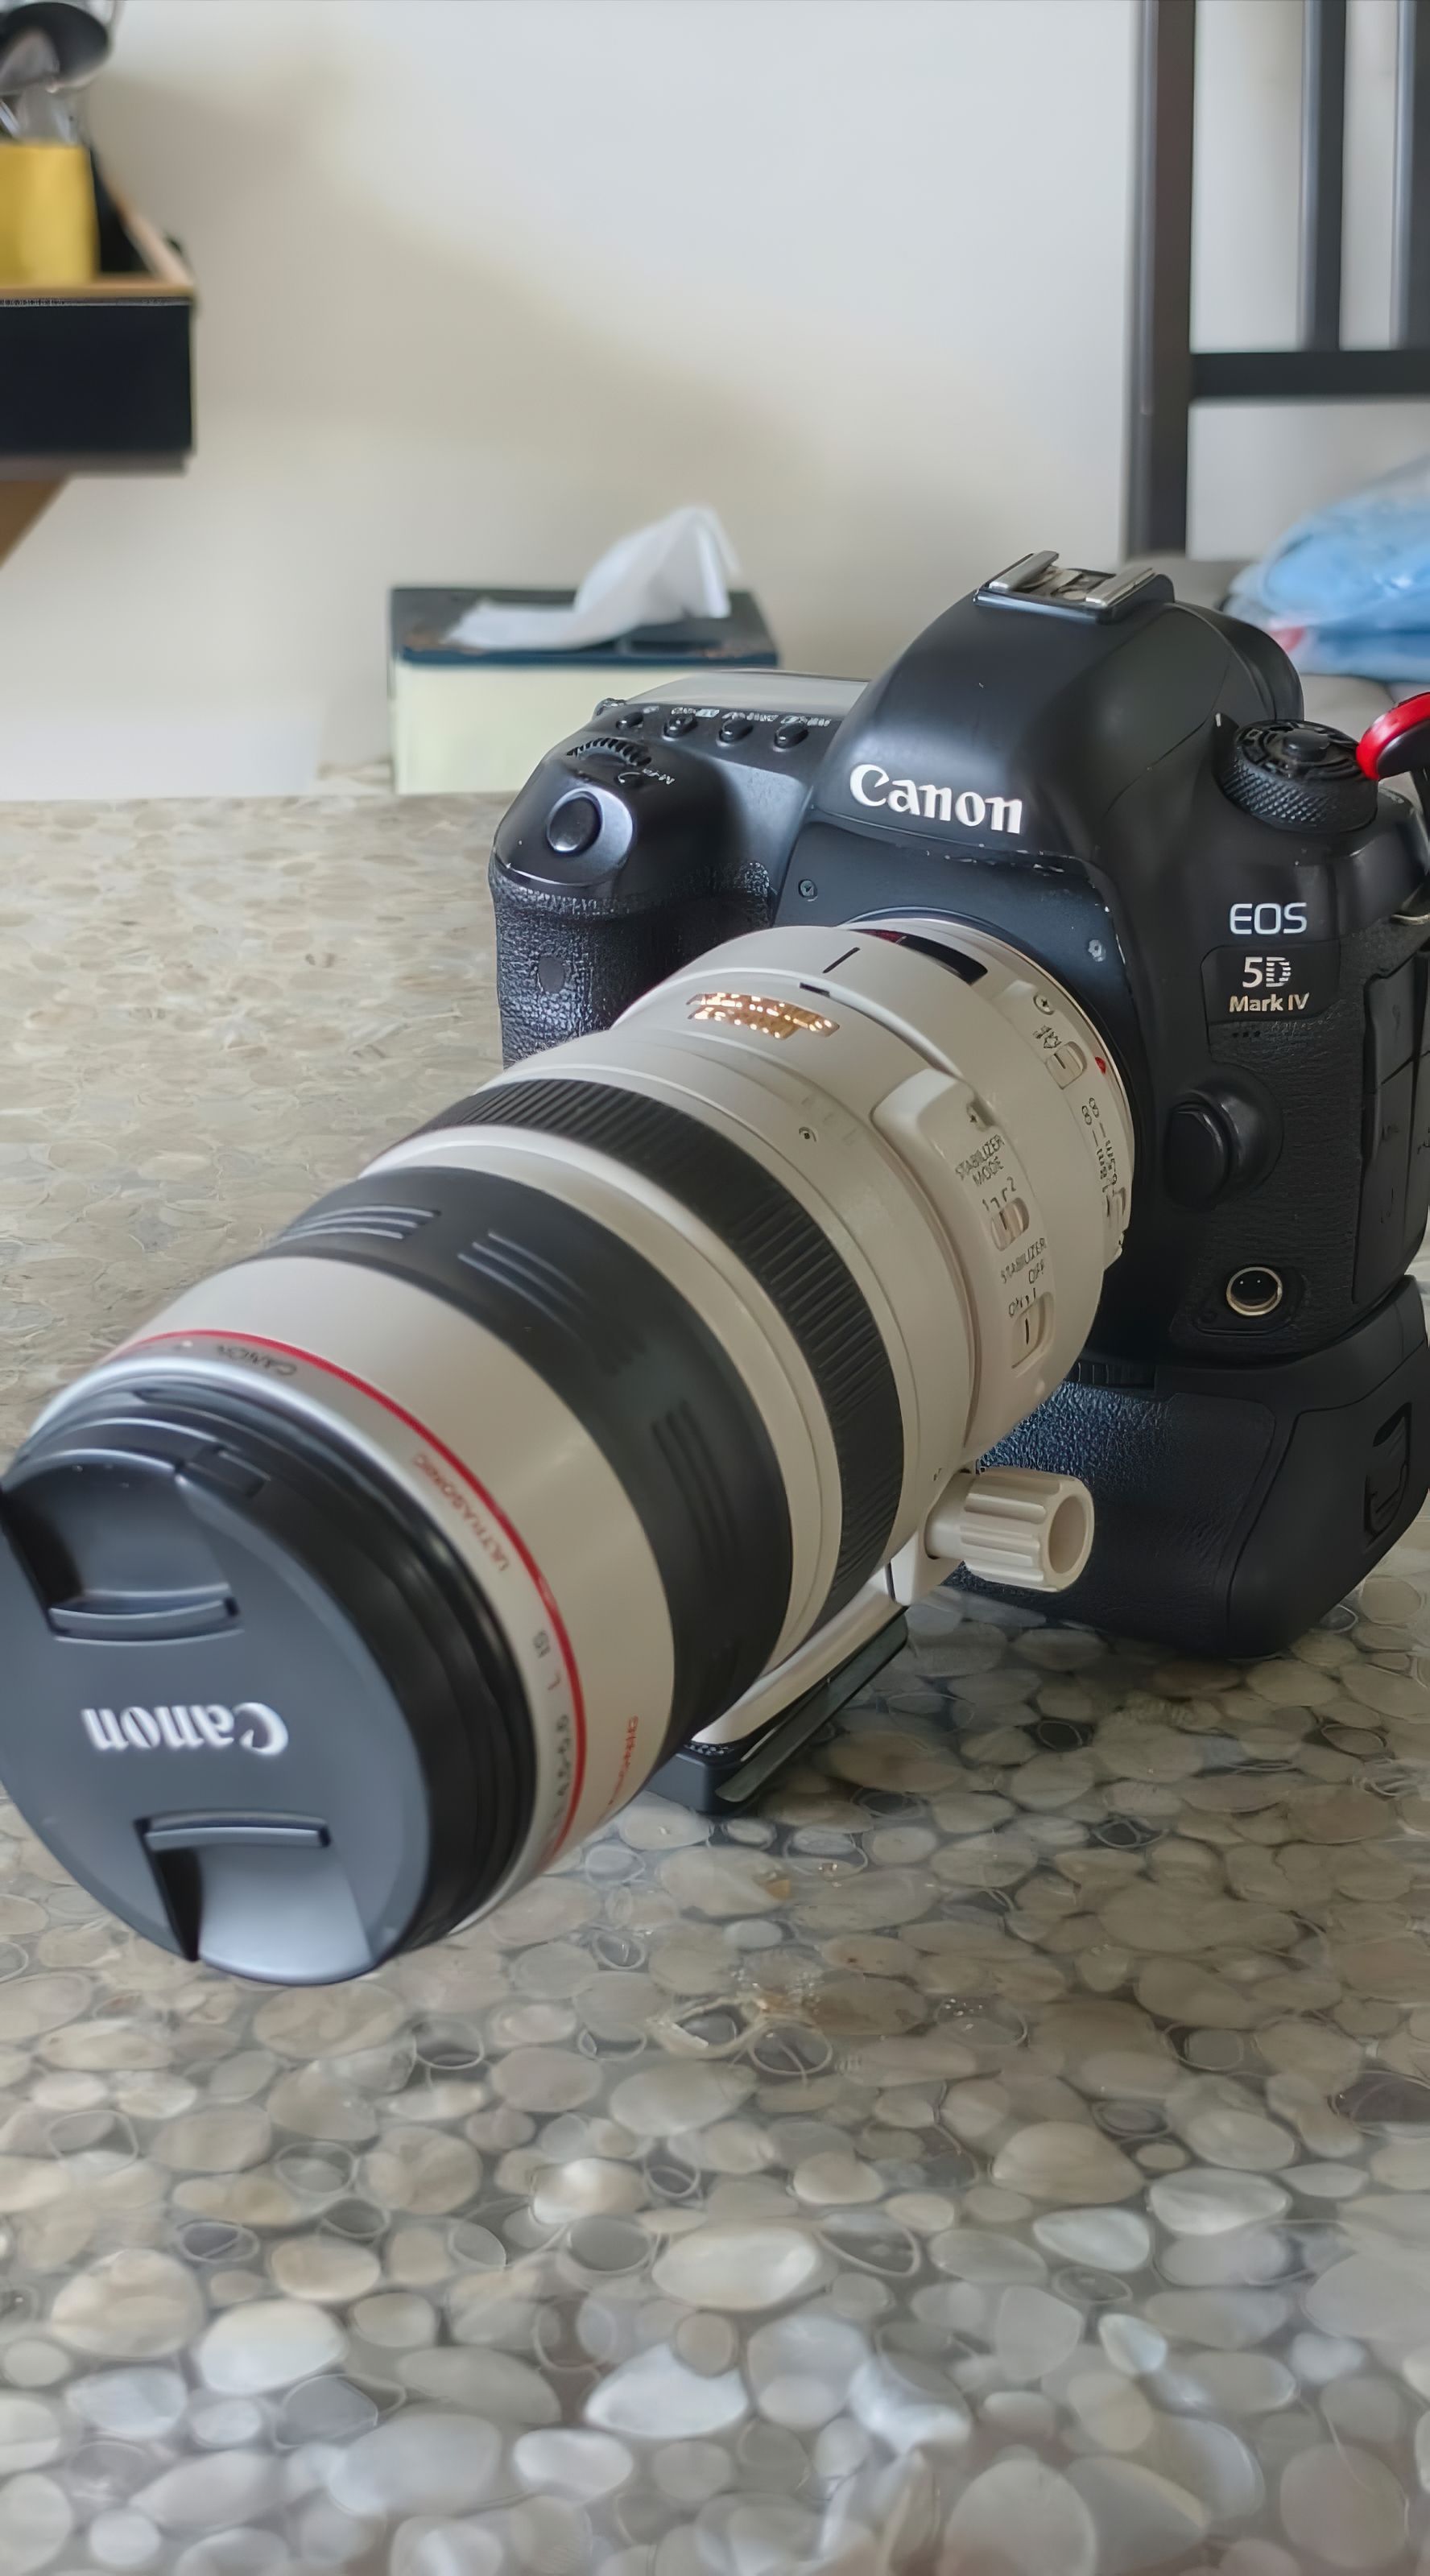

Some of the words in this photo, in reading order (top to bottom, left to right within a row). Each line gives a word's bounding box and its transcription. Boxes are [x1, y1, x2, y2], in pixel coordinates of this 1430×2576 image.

[849, 763, 1023, 834] Canon
[1229, 902, 1308, 935] EOS
[1242, 956, 1292, 989] 5D
[1229, 993, 1284, 1013] Mark
[1287, 991, 1311, 1011] IV
[955, 1133, 1006, 1181] STABILIZER
[971, 1155, 1005, 1187] MODE
[1000, 1236, 1047, 1285] STABILIZER
[411, 1451, 510, 1572] ULTRASONIC
[80, 1702, 289, 1756] Canon
